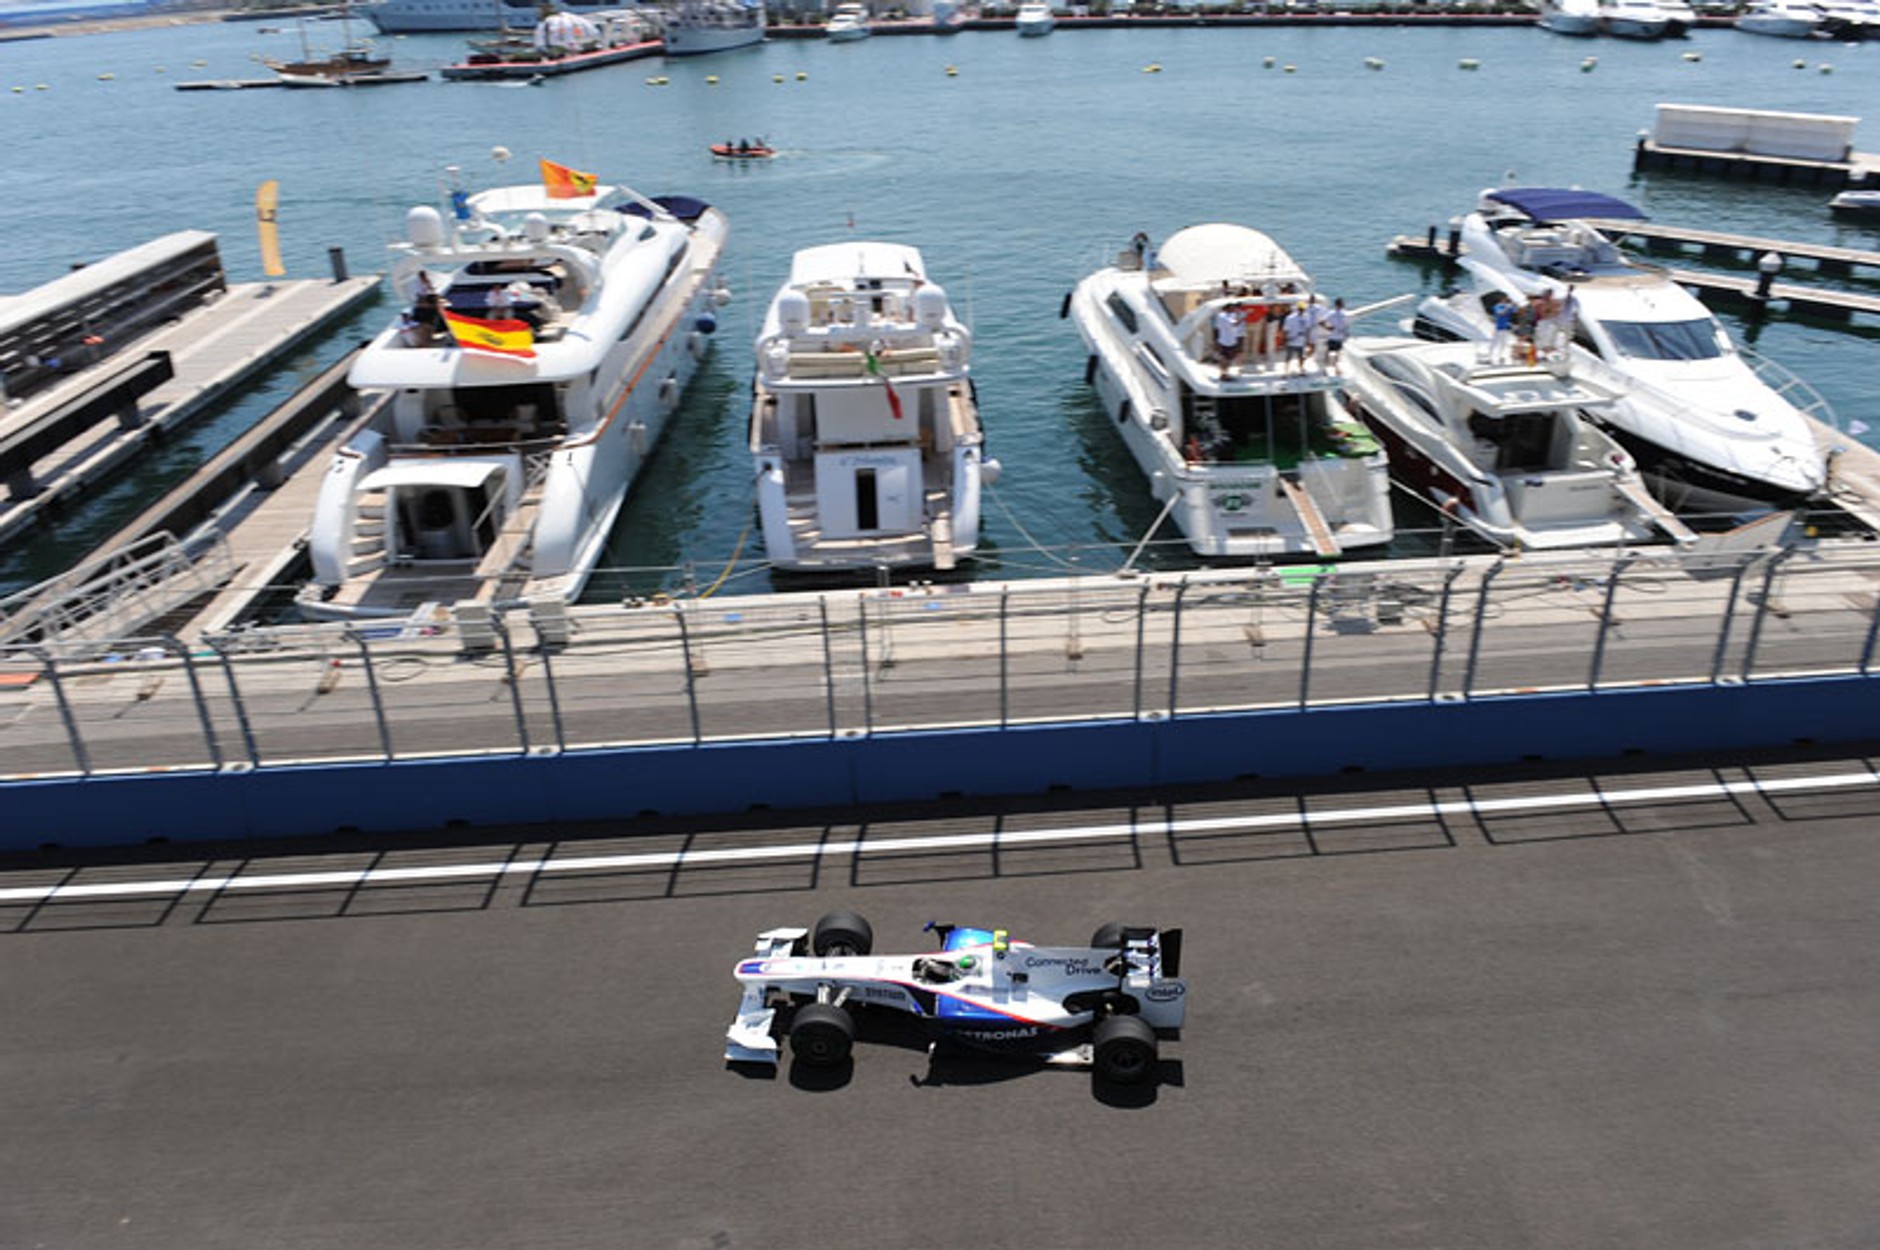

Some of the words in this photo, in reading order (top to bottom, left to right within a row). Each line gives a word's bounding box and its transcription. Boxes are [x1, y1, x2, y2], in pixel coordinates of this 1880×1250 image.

[1025, 956, 1089, 967] Connected
[1065, 963, 1102, 976] Drive
[958, 1026, 1039, 1041] TRONAS
